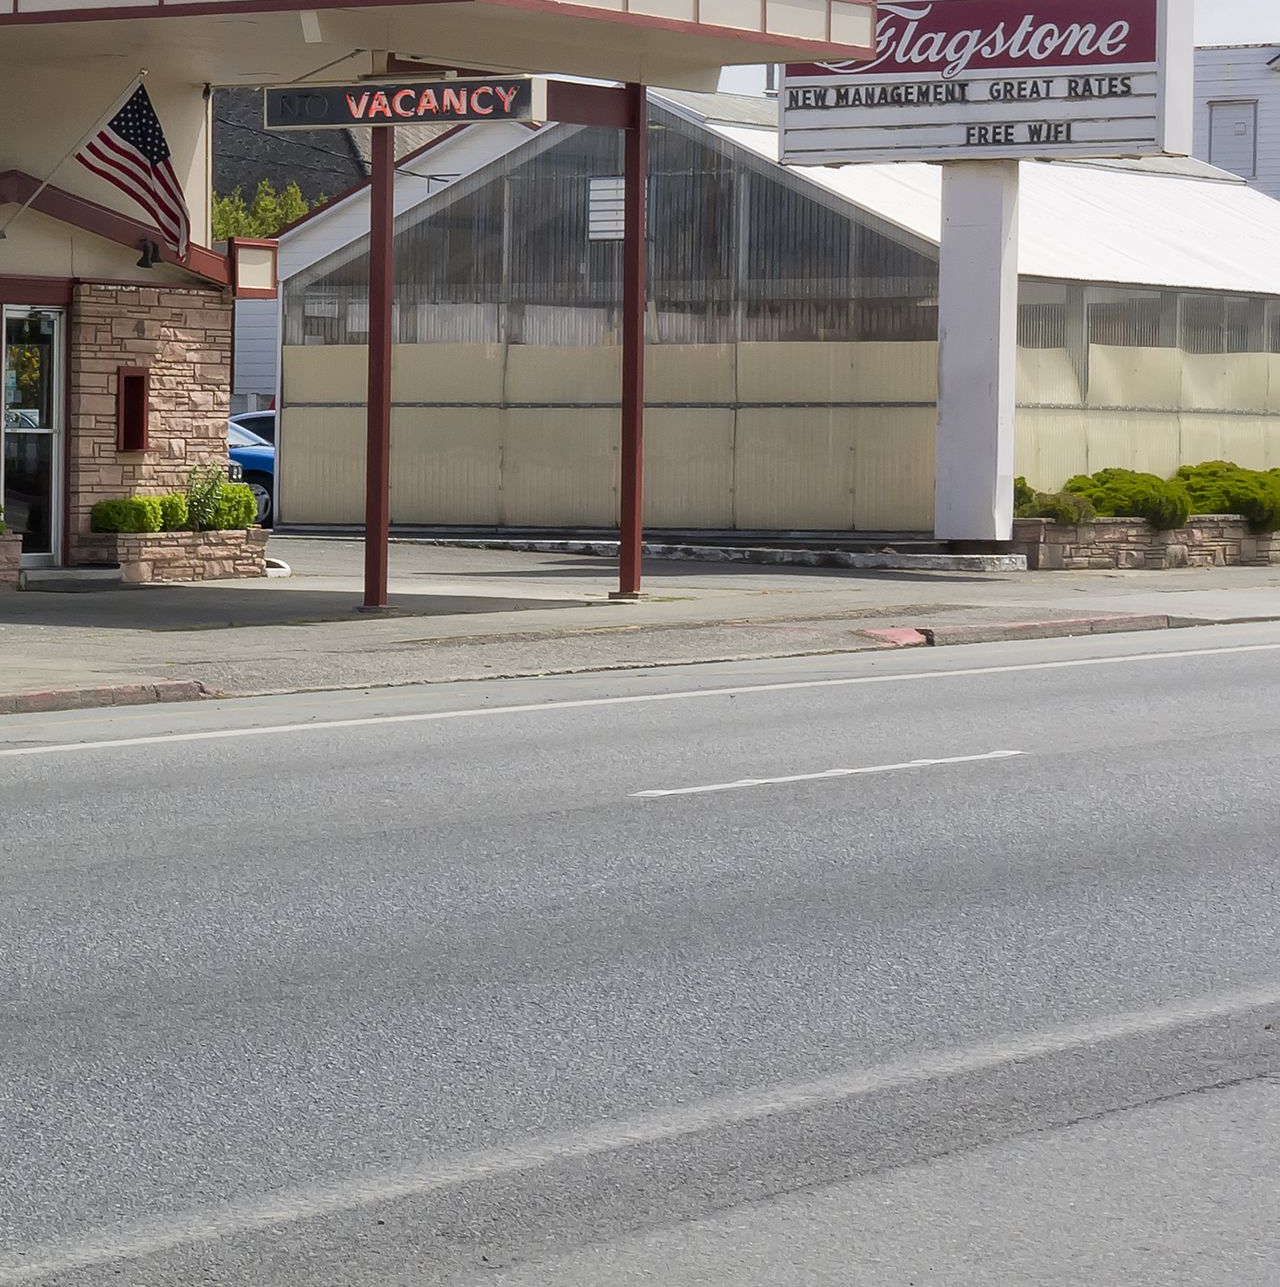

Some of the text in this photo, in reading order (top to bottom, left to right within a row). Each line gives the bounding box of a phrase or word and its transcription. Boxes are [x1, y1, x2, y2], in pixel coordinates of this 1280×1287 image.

[346, 85, 520, 119] VACANCY
[788, 76, 1132, 109] NEW MANAGEMENT GREAT RATES
[966, 123, 1072, 145] FREE WIFI
